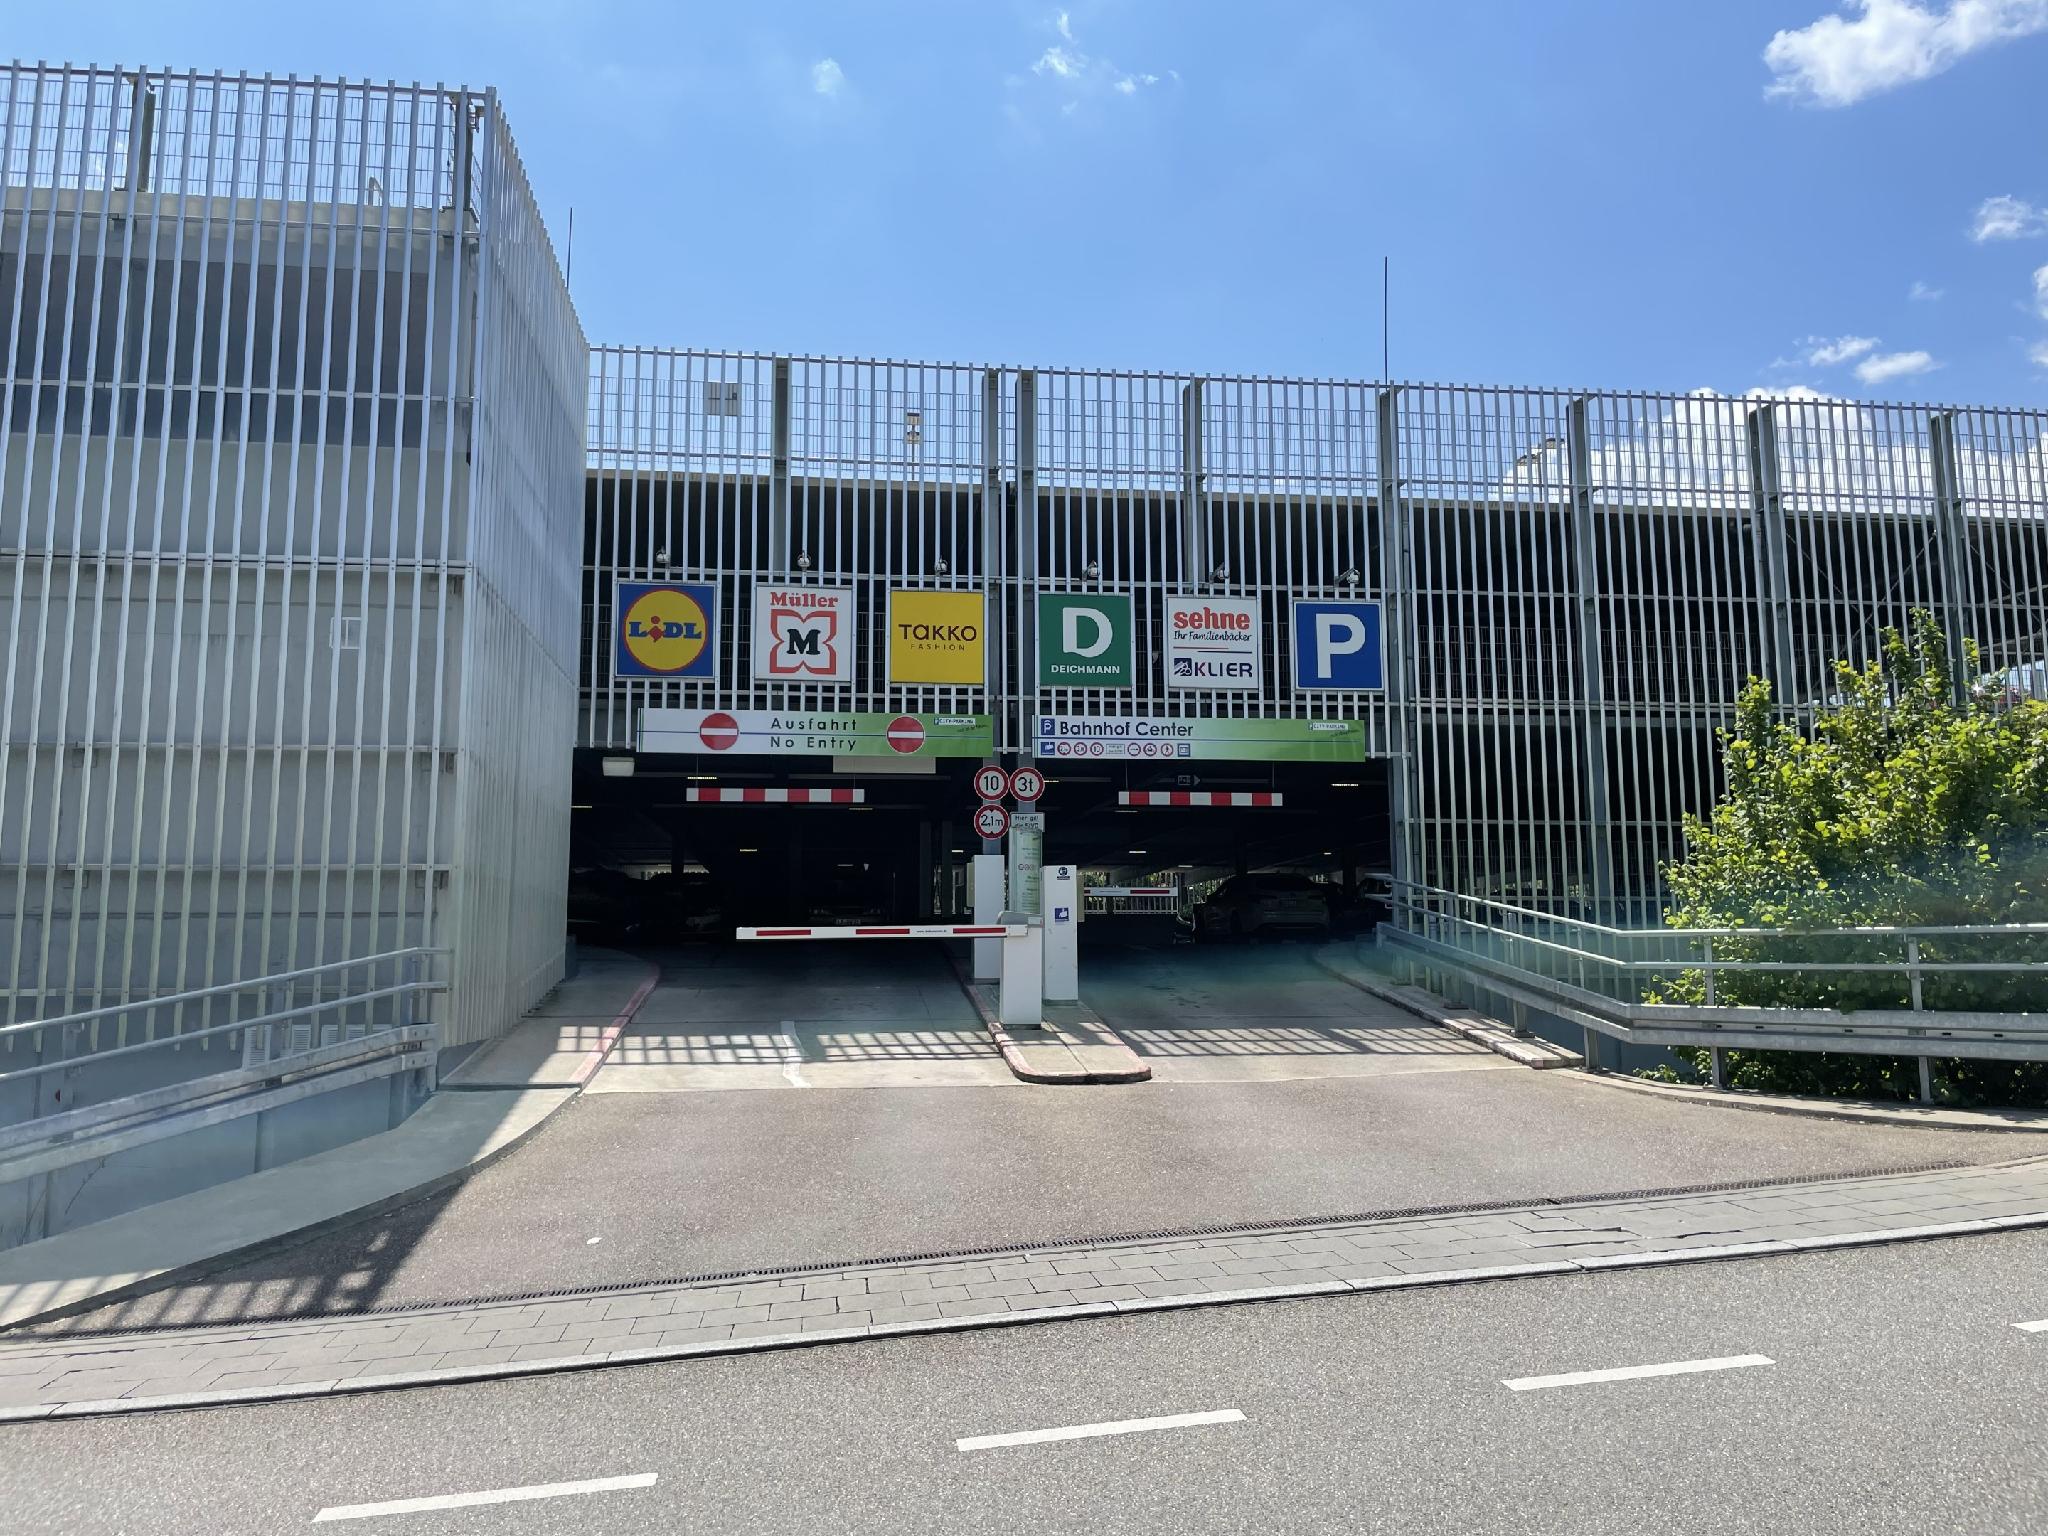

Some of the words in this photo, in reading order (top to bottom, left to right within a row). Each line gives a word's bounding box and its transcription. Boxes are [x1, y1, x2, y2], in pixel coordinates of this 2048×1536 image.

[770, 591, 839, 608] Müller
[1173, 606, 1251, 630] sehne
[1062, 606, 1113, 658] D
[1173, 630, 1188, 640] Ihr
[1188, 630, 1252, 642] Familienbäcker
[786, 628, 821, 655] M
[910, 643, 965, 652] FASHION
[1315, 613, 1366, 679] P
[1051, 664, 1120, 674] DEICHMANN
[1194, 661, 1253, 678] KLIER
[771, 717, 857, 731] Ausfahrt
[1060, 721, 1131, 736] Bahnhof
[1135, 722, 1194, 737] Center
[770, 736, 795, 748] No
[807, 736, 857, 752] Entry
[984, 775, 999, 791] 10
